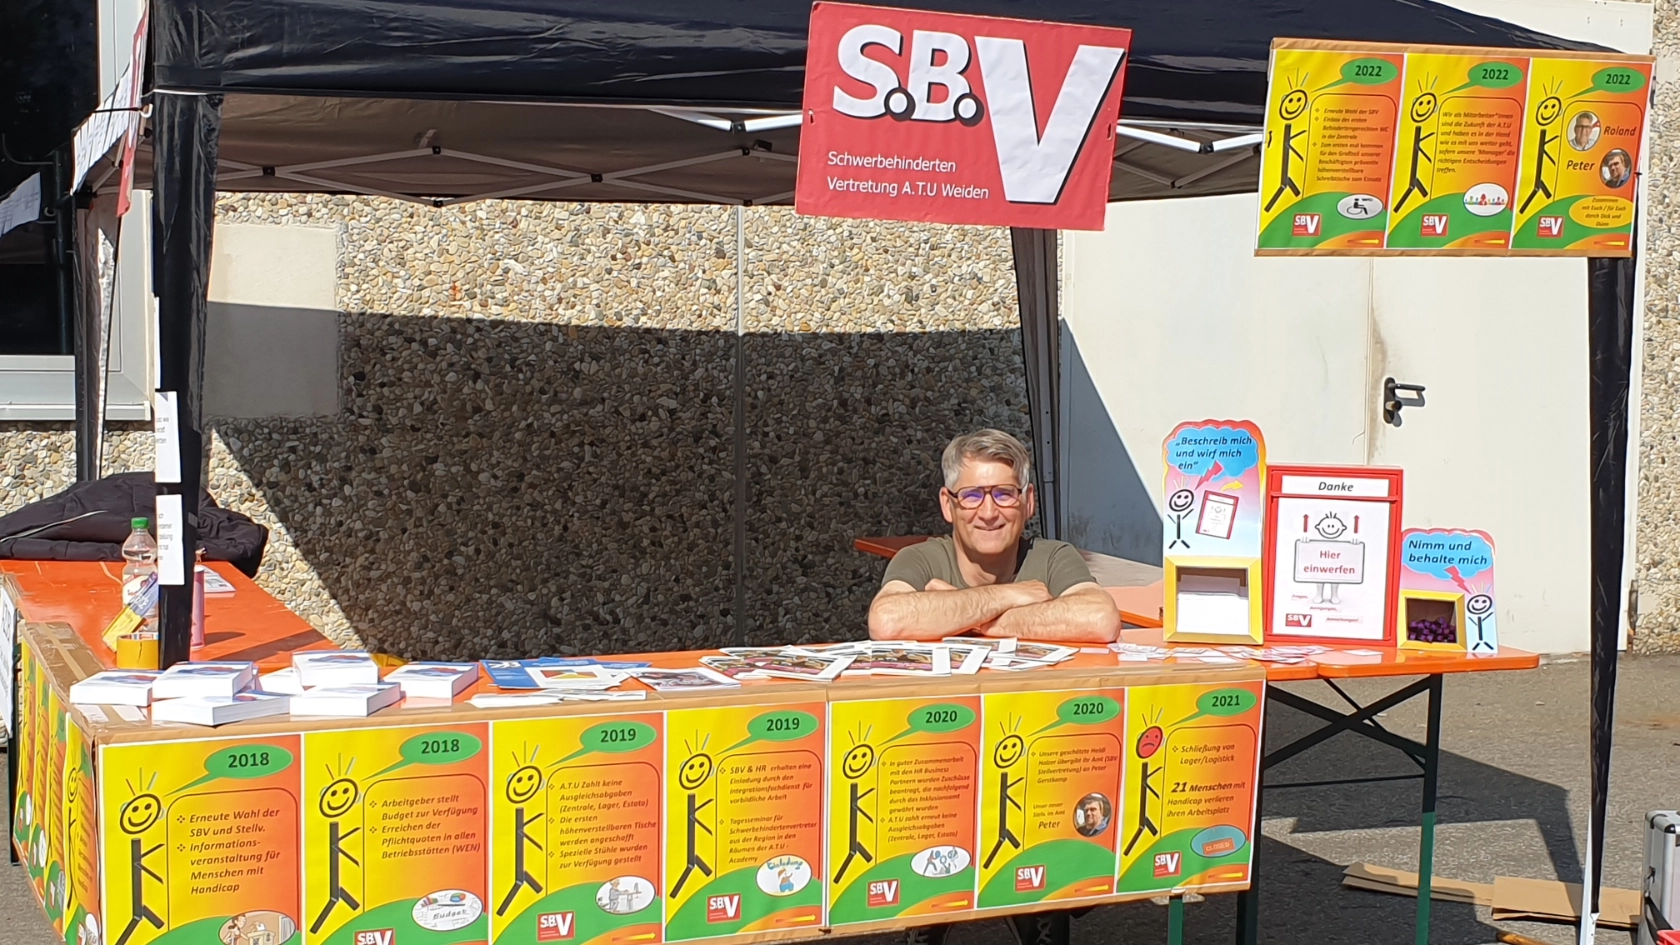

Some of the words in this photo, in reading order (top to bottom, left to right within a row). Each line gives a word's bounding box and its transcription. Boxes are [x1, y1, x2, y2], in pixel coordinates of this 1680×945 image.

[1354, 65, 1382, 77] 2022
[1481, 68, 1509, 80] 2022
[1605, 73, 1631, 85] 2022
[1603, 126, 1637, 137] Roland
[827, 151, 956, 173] Schwerbehinderten
[1566, 160, 1595, 171] Peter
[827, 176, 898, 197] Vertretung
[902, 182, 937, 196] A.T.U
[942, 183, 989, 199] Weiden
[1230, 436, 1252, 445] mich
[1176, 449, 1194, 458] und
[1197, 449, 1217, 460] wirf
[1219, 449, 1242, 458] mich
[1318, 481, 1354, 492] Danke
[1408, 540, 1445, 550] Nimm
[1448, 541, 1472, 551] und
[1319, 550, 1341, 560] Hier
[1408, 553, 1455, 564] behalte
[1458, 555, 1487, 565] mich
[1303, 564, 1356, 575] einwerfen
[1211, 695, 1240, 707] 2021
[1072, 702, 1103, 715] 2020
[925, 710, 958, 724] 2020
[766, 717, 800, 732] 2019
[600, 728, 636, 743] 2019
[420, 739, 460, 754] 2018
[1180, 745, 1220, 753] Schließung
[228, 752, 270, 769] 2018
[730, 766, 745, 775] SBV
[755, 764, 767, 772] HR
[559, 782, 580, 790] A.T.U
[581, 780, 601, 789] Zahlt
[602, 779, 623, 787] keine
[730, 776, 762, 785] Einladung
[762, 774, 781, 782] durch
[802, 782, 813, 791] für
[1171, 782, 1187, 793] 21
[1189, 782, 1232, 792] Menschen
[1233, 781, 1246, 789] mit
[381, 797, 436, 808] Arbeitgeber
[437, 794, 459, 803] stellt
[559, 789, 632, 802] Ausgleichsabgaben
[1167, 797, 1203, 806] Handicap
[1204, 795, 1235, 804] verlieren
[190, 813, 230, 823] Erneute
[233, 809, 261, 819] Wahl
[262, 808, 280, 818] der
[382, 811, 414, 822] Budget
[416, 810, 431, 818] zur
[432, 807, 479, 817] Verfügung
[1167, 809, 1186, 817] ihren
[1187, 807, 1230, 817] Arbeitsplatz
[559, 816, 573, 824] Die
[574, 815, 598, 823] ersten
[730, 816, 772, 825] Tagesseminar
[773, 814, 783, 822] für
[1038, 821, 1060, 830] Peter
[190, 828, 211, 838] SBV
[213, 826, 233, 835] und
[235, 823, 266, 834] Stellv.
[382, 823, 424, 834] Erreichen
[425, 821, 442, 829] der
[559, 824, 632, 835] höhenverstellbaren
[634, 821, 657, 829] Tische
[729, 822, 817, 835] Schwerbehindertenvertreter
[888, 823, 945, 833] Ausgleichsabgaben
[382, 835, 442, 848] Pflichtquoten
[443, 833, 452, 841] in
[454, 831, 476, 840] allen
[559, 837, 588, 846] werden
[590, 833, 635, 844] angeschafft
[753, 835, 775, 843] Region
[190, 839, 261, 853] Informations-
[382, 847, 450, 859] Betriebsstätten
[452, 843, 480, 854] (WEN)
[559, 848, 592, 858] Spezielle
[594, 846, 618, 854] Stühle
[619, 843, 648, 852] wurden
[1205, 842, 1230, 851] CLOSED
[190, 853, 262, 866] veranstaltung
[264, 850, 281, 862] für
[573, 858, 612, 868] Verfügung
[614, 855, 642, 865] gestellt
[728, 856, 758, 864] Academy
[191, 868, 244, 880] Menschen
[247, 866, 264, 875] mit
[191, 883, 240, 895] Handicap
[433, 908, 467, 920] Budget
